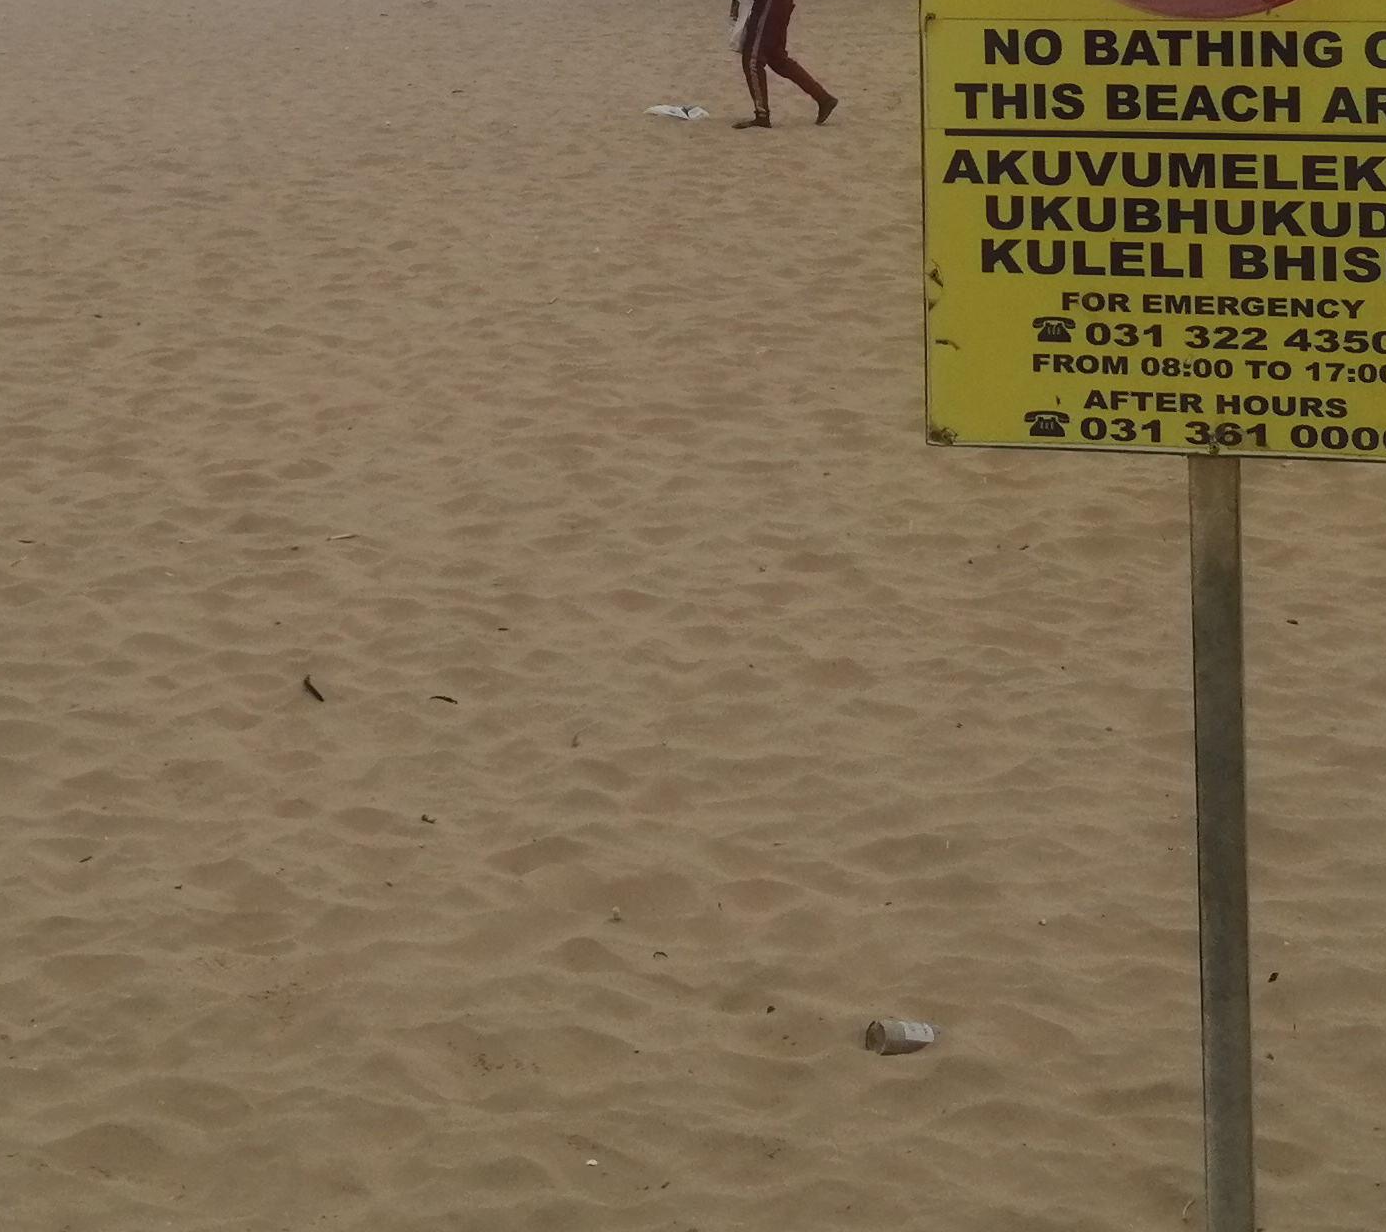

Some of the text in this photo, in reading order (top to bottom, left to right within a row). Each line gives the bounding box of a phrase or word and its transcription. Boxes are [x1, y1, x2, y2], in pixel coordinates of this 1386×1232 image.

[984, 29, 1062, 65] NO
[1084, 30, 1342, 68] BATHING
[955, 83, 1084, 120] THIS
[1107, 84, 1300, 122] BEACH
[982, 239, 1203, 278] KULELI
[1062, 292, 1365, 319] FOR EMERGENCY
[1086, 322, 1162, 347] 031
[1185, 326, 1267, 350] 322
[1033, 354, 1128, 375] FROM
[1141, 357, 1233, 378] 08:00
[1245, 360, 1291, 380] TO
[1084, 390, 1347, 418] AFTER HOURS
[1081, 417, 1160, 442] 031
[1185, 422, 1267, 448] 361
